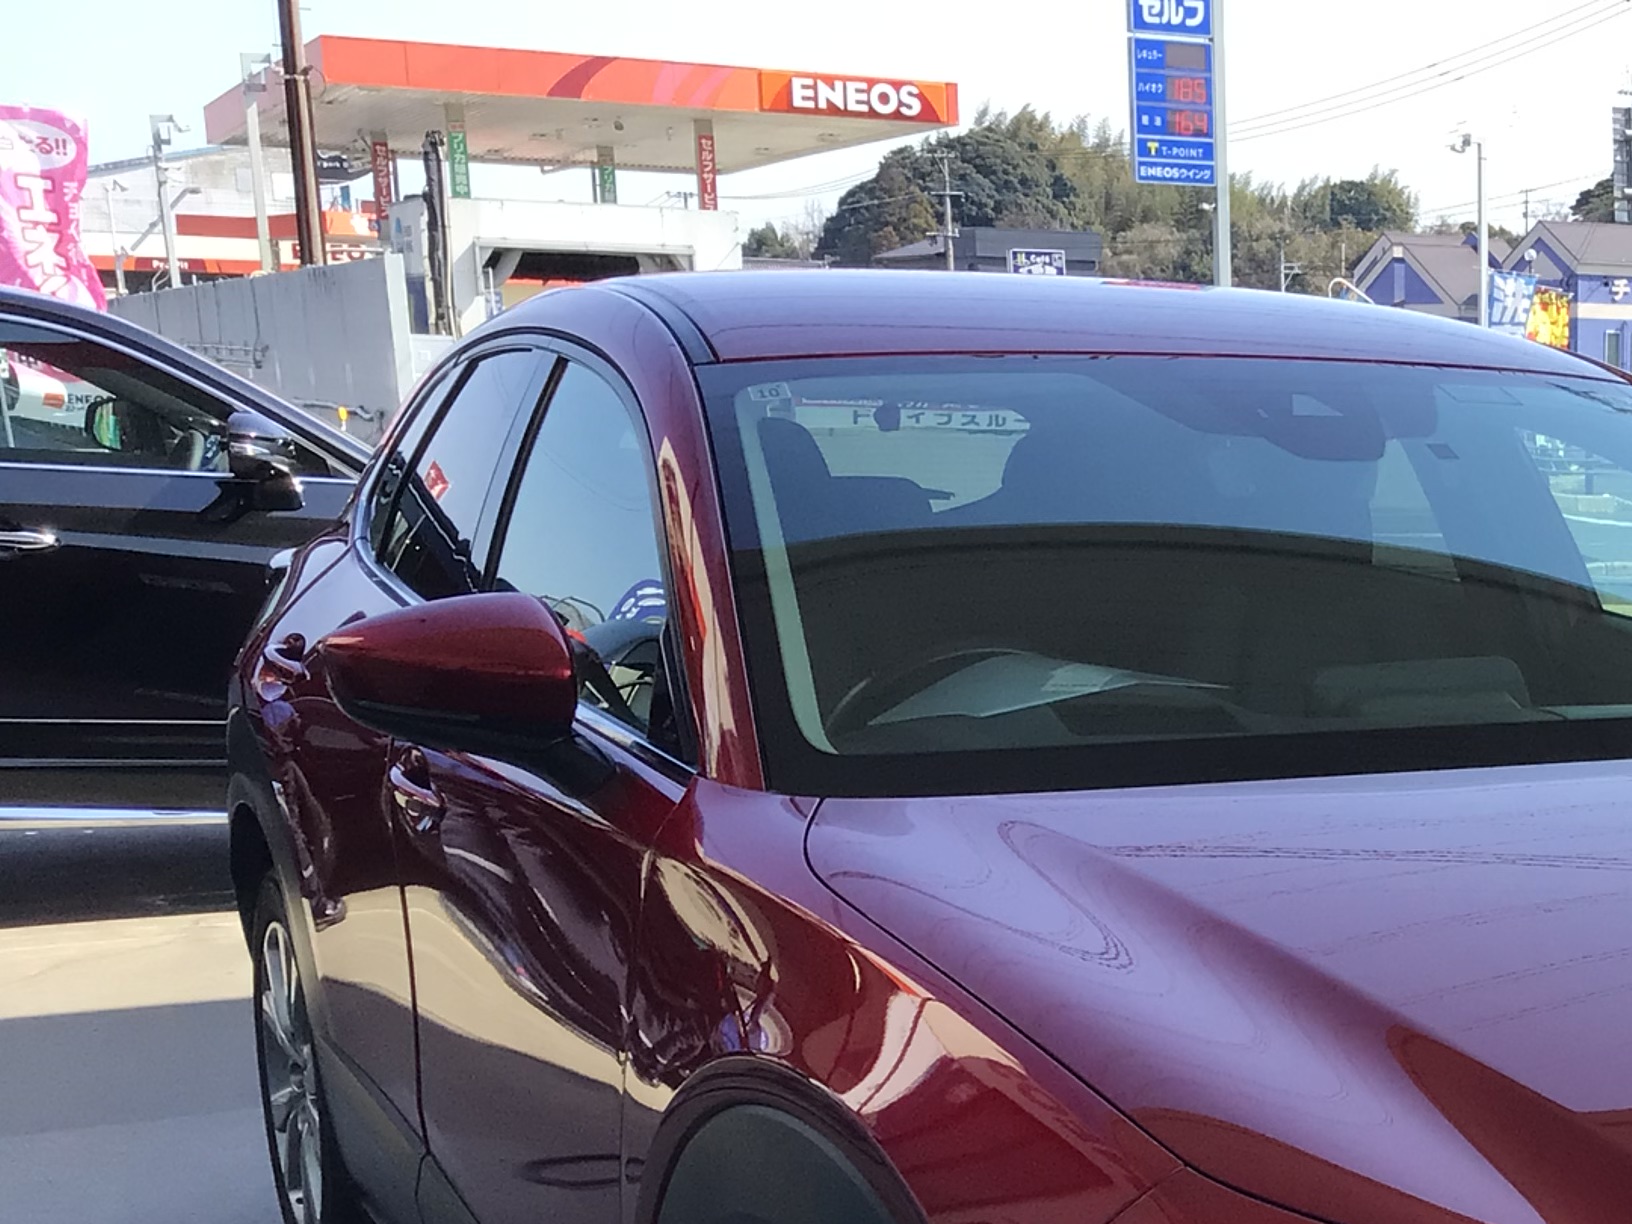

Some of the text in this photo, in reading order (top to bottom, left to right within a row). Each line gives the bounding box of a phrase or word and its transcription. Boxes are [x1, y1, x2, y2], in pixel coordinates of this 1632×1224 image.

[1138, 0, 1205, 27] セルフ
[791, 76, 922, 117] ENEOS
[1161, 146, 1204, 158] T-POINT
[1140, 165, 1212, 180] ENEOSウイング
[852, 409, 1029, 428] ドイブスルー
